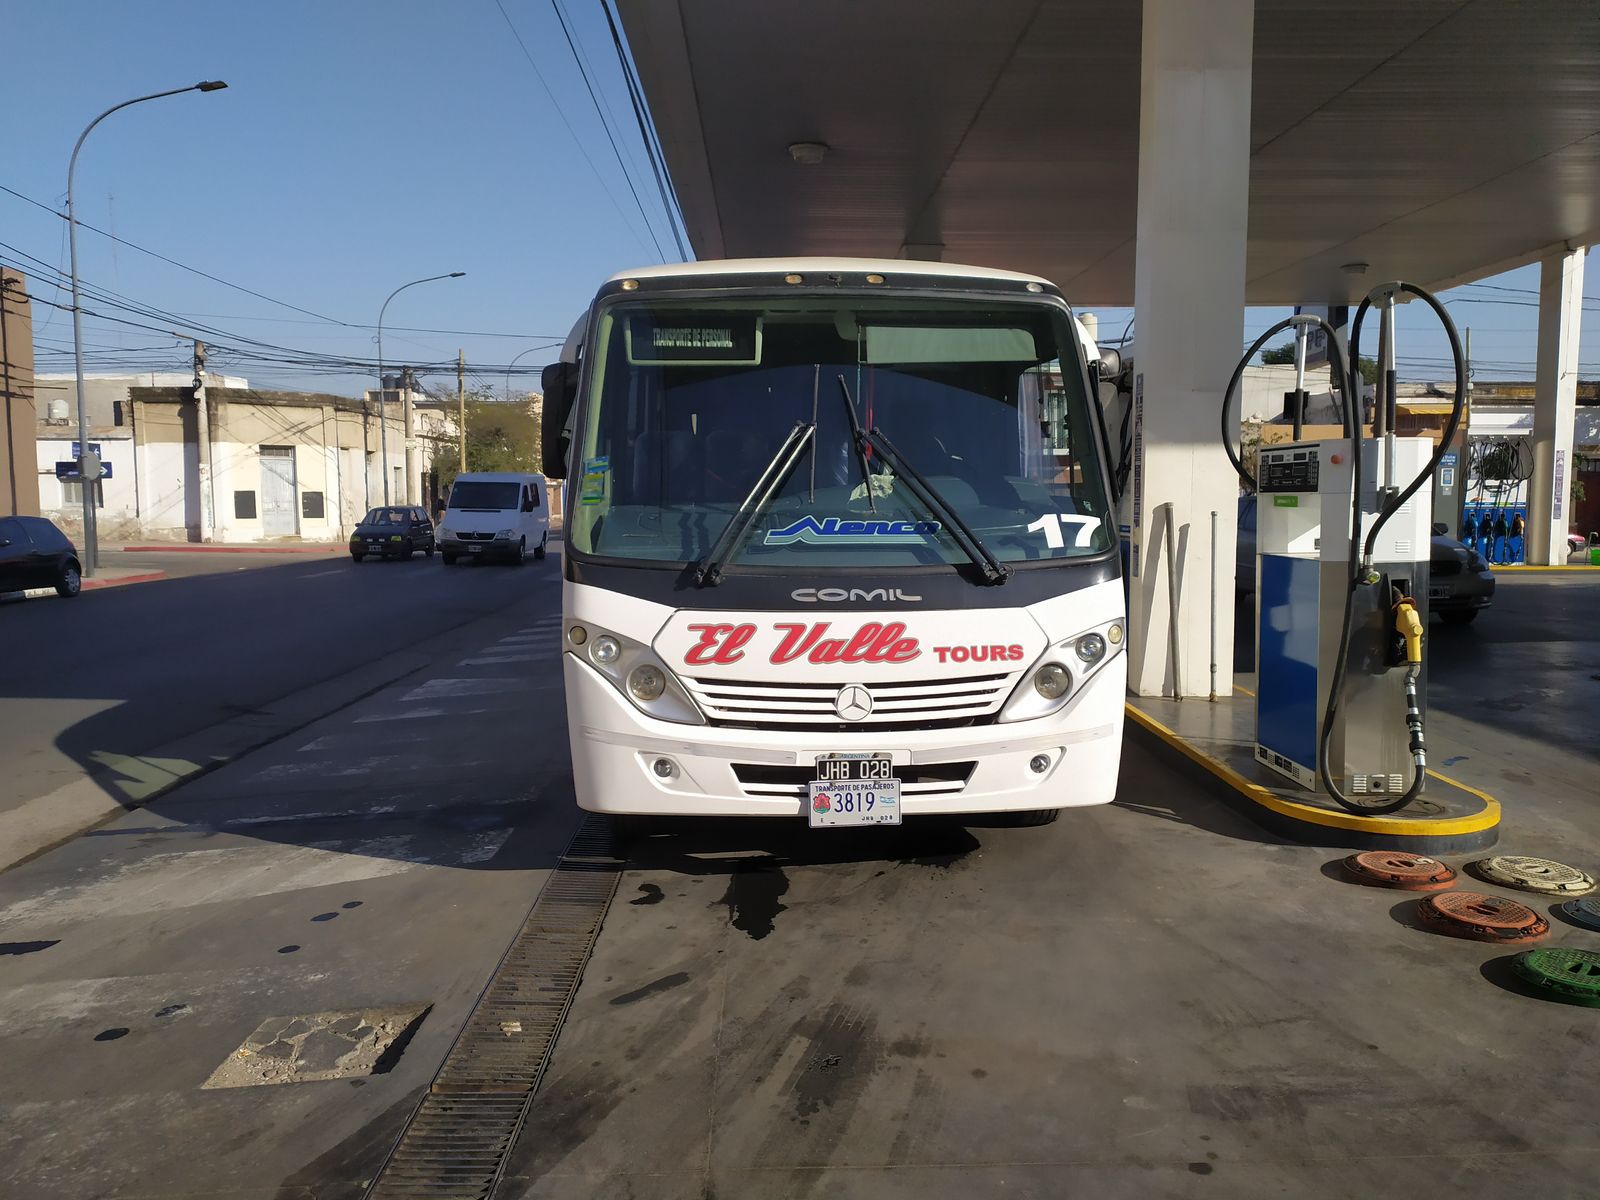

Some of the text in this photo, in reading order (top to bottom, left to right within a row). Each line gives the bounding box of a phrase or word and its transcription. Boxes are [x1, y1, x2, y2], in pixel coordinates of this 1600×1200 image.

[766, 515, 942, 537] Alenco
[1027, 513, 1102, 549] 17
[791, 588, 922, 602] COMIL
[684, 621, 1024, 666] El Valle TOURS
[820, 760, 890, 780] JHB 028
[815, 784, 851, 792] TRANSPORTE
[860, 783, 895, 791] PASAJEROS
[834, 792, 875, 812] 3819
